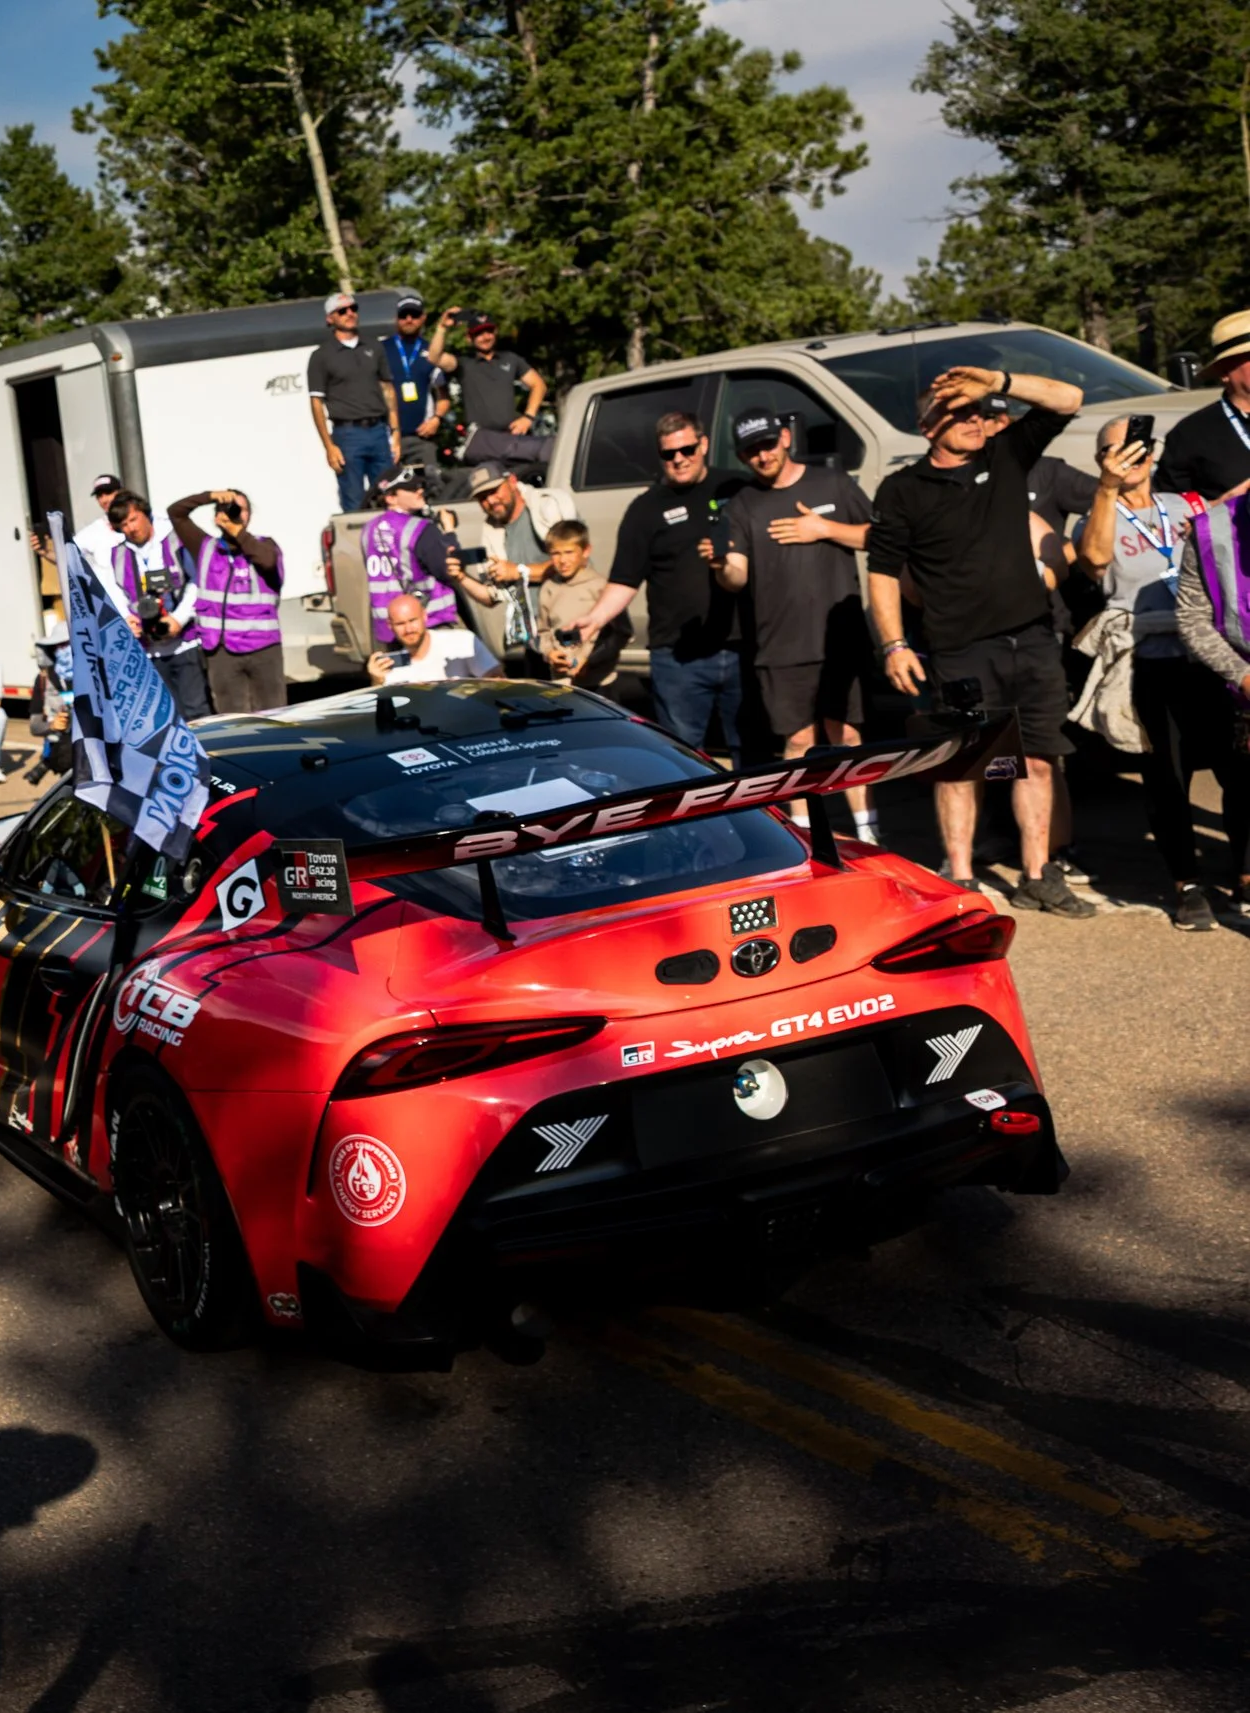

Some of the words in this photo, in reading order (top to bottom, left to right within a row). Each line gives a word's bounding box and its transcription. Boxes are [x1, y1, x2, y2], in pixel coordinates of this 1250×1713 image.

[458, 741, 497, 752] Toyota
[469, 745, 520, 757] Colorado
[520, 738, 562, 750] Springs
[402, 760, 459, 776] TOYOTA
[454, 799, 653, 860] BYE
[672, 740, 953, 816] FELICIA
[307, 853, 337, 864] TOYOTA
[284, 866, 308, 886] GR
[226, 877, 258, 918] G
[292, 892, 310, 900] NORTH
[311, 892, 338, 901] AMERICA
[126, 978, 202, 1030] TCB
[137, 1016, 184, 1047] RACING
[624, 1050, 653, 1065] GR
[664, 1030, 767, 1059] Supra
[771, 1011, 824, 1037] GT4
[828, 994, 896, 1025] EVO2
[971, 1094, 998, 1105] TOW
[334, 1149, 346, 1171] KINGS
[355, 1141, 398, 1180] COMPRESSION
[336, 1182, 361, 1216] ENERGY
[361, 1191, 398, 1219] SERVICES
